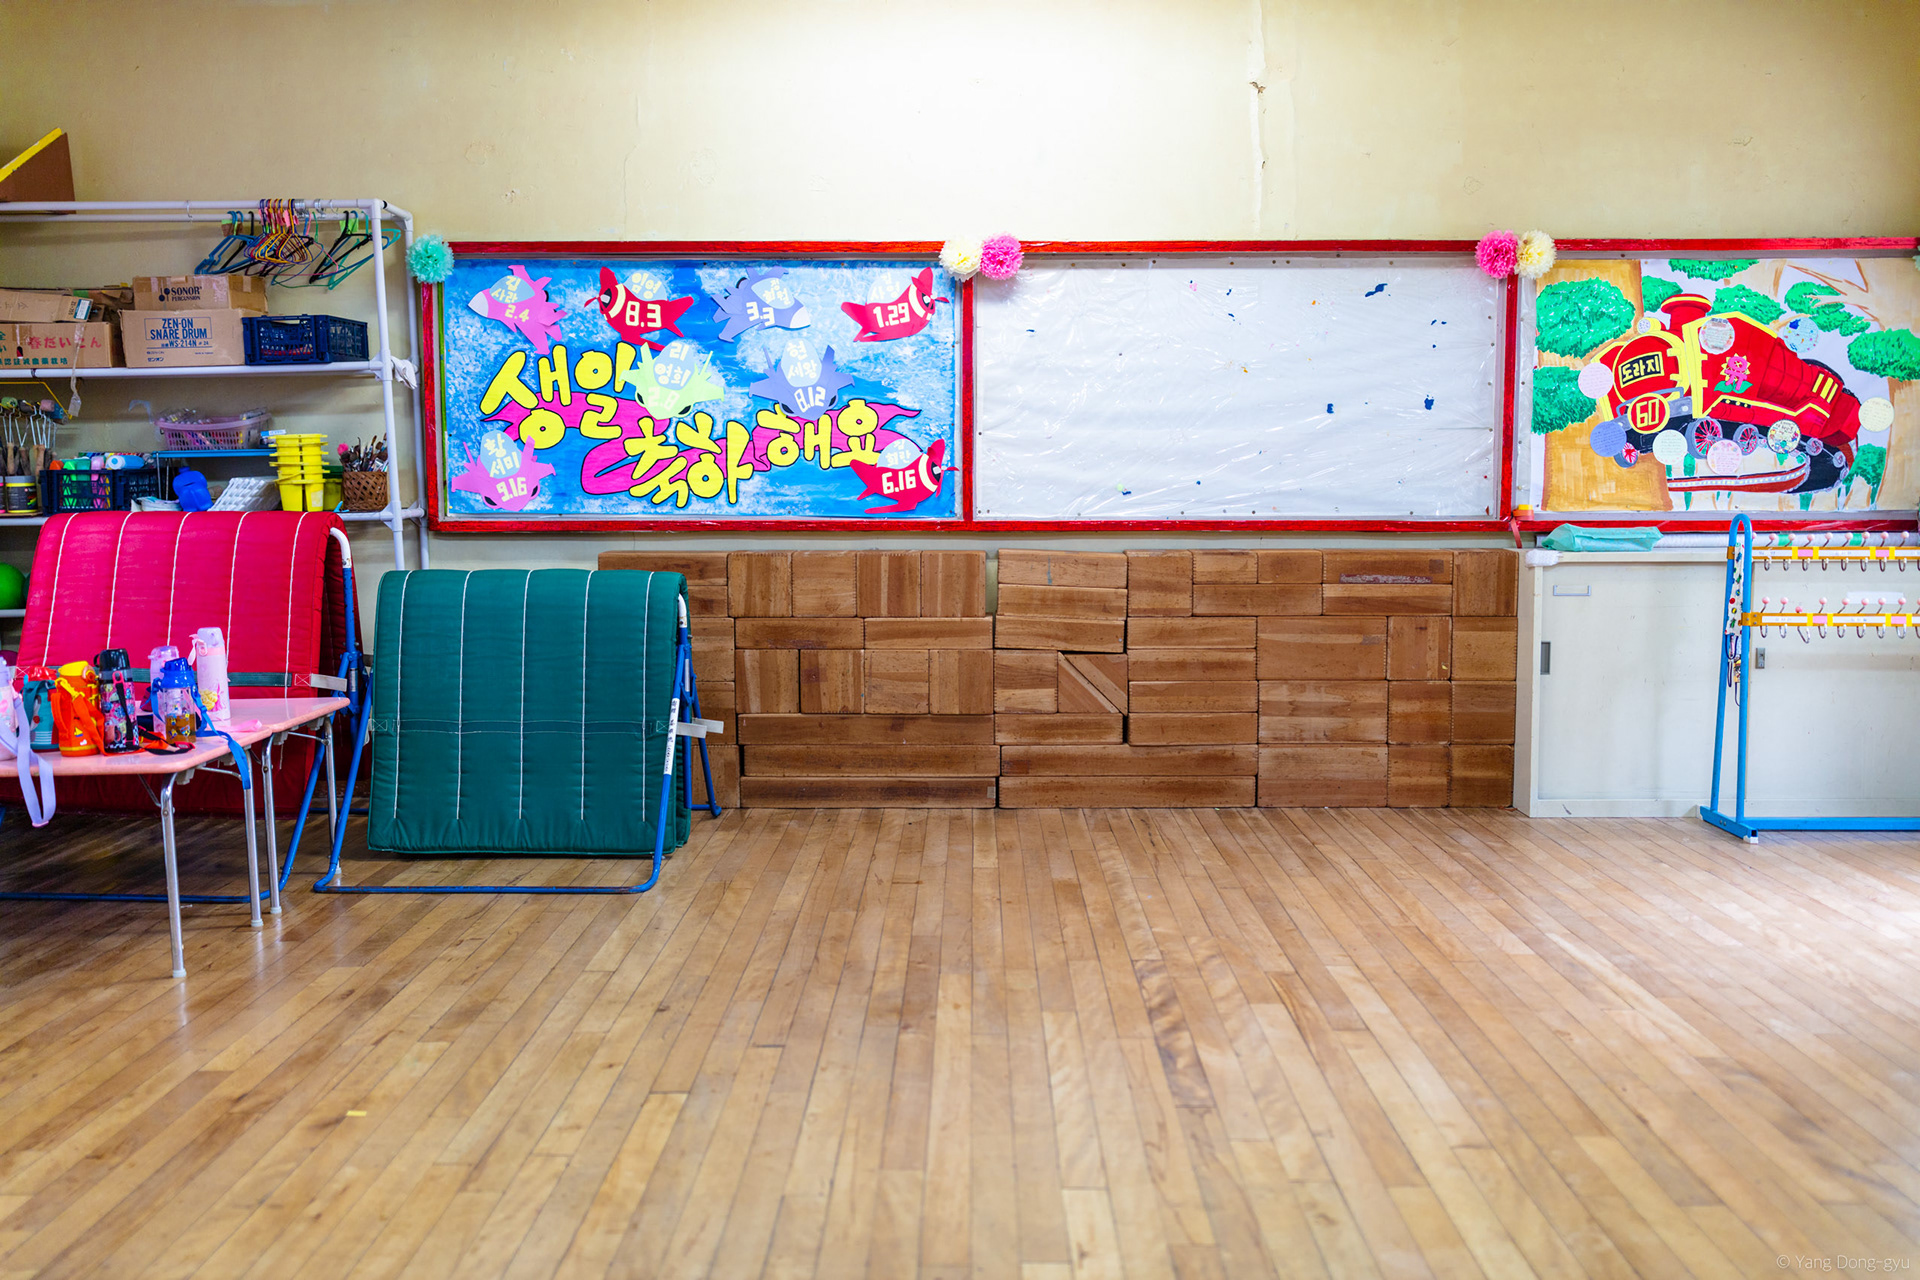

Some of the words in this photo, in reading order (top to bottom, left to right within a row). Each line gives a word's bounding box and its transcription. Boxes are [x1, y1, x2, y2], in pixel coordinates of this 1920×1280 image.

[171, 286, 200, 296] SONOR
[162, 318, 193, 329] ZEN-ON
[505, 304, 530, 322] 2.4
[625, 300, 662, 328] 8.3
[746, 301, 775, 327] 3.3
[872, 302, 910, 328] 1.29
[150, 329, 179, 340] SNARE
[182, 328, 207, 339] DRUM
[669, 342, 690, 361] 리
[654, 363, 691, 387] 영희
[1622, 355, 1660, 382] 도라지
[648, 386, 680, 411] 2.8
[794, 386, 826, 413] 8.12
[480, 341, 637, 450] 생일
[624, 399, 882, 508] 축하해요
[1635, 398, 1660, 428] 60
[484, 433, 507, 457] 황
[489, 451, 521, 477] 서미
[496, 477, 528, 502] 9.16
[881, 469, 916, 494] 6.16
